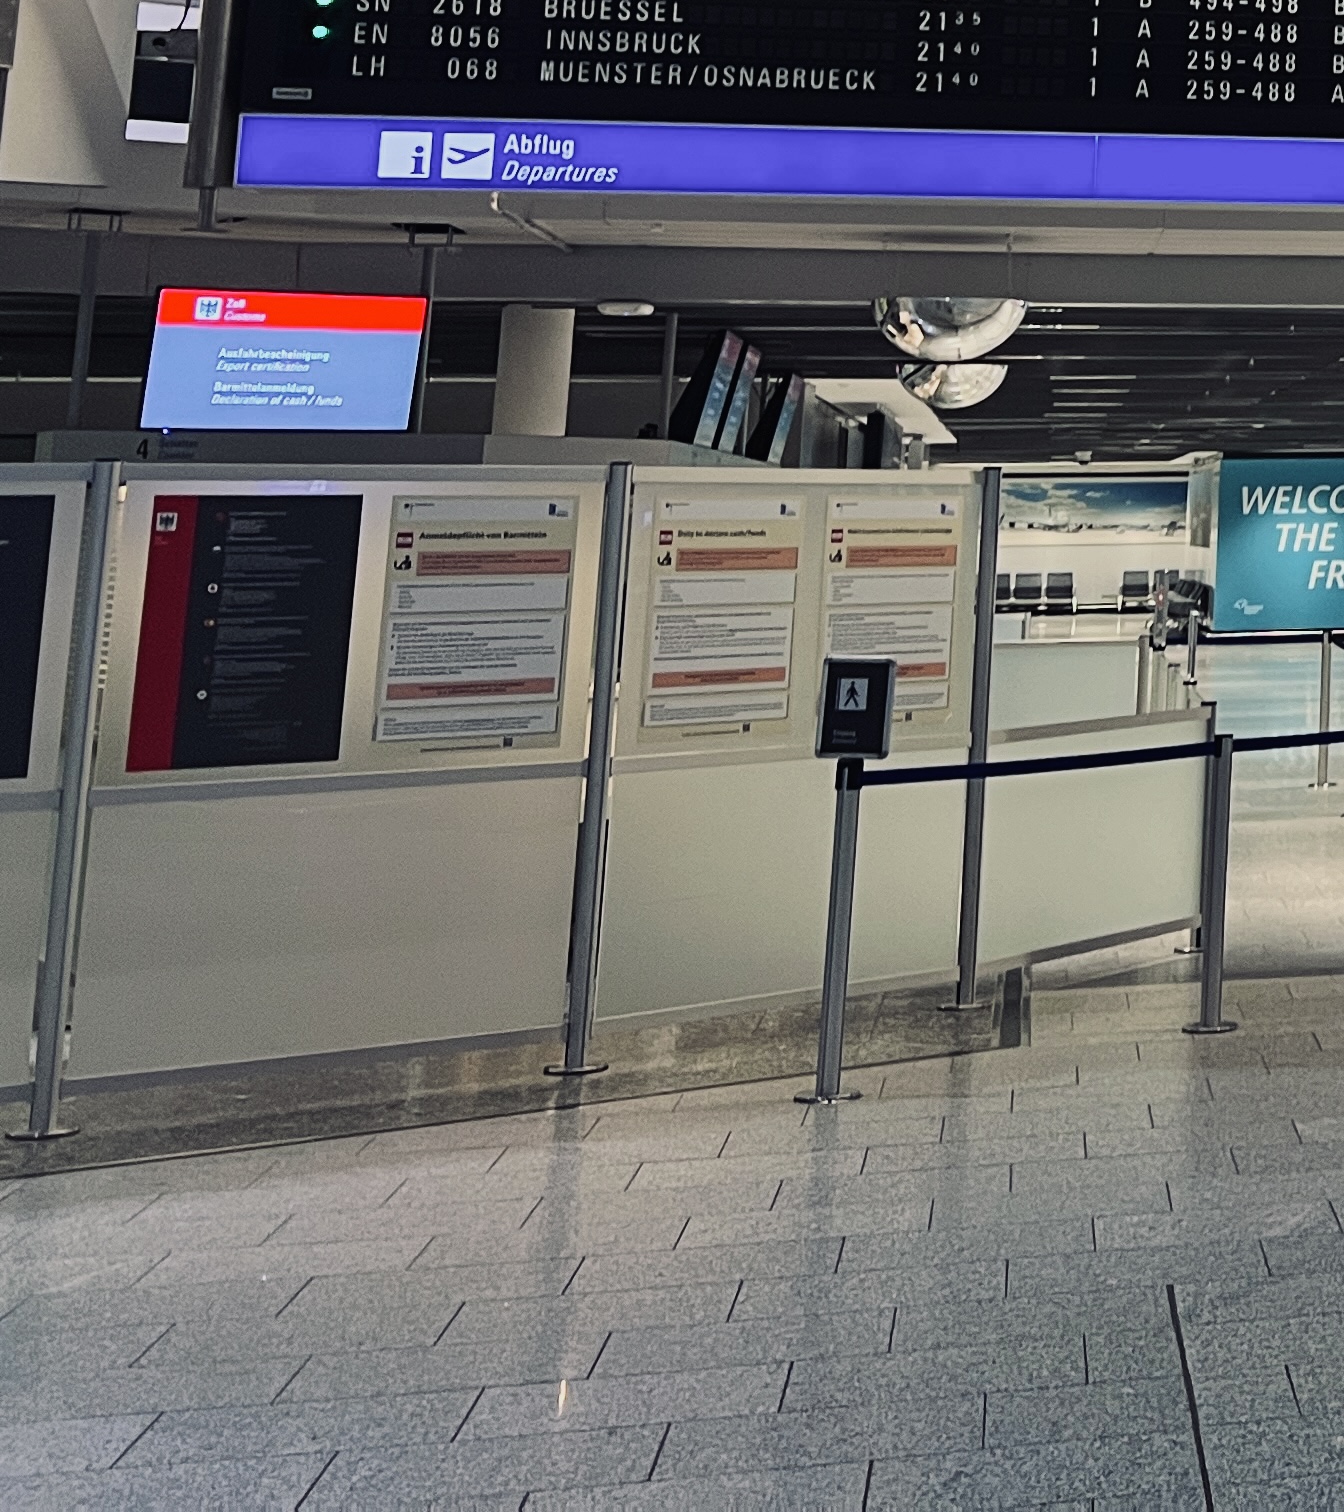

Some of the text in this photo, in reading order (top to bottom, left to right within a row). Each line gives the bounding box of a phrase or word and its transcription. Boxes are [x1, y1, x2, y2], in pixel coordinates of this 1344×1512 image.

[446, 57, 497, 80] 068
[539, 60, 875, 90] MUENSTER/OSNABRUECK
[503, 133, 575, 160] Abflug
[501, 159, 619, 186] Departures
[1275, 522, 1339, 553] THE
